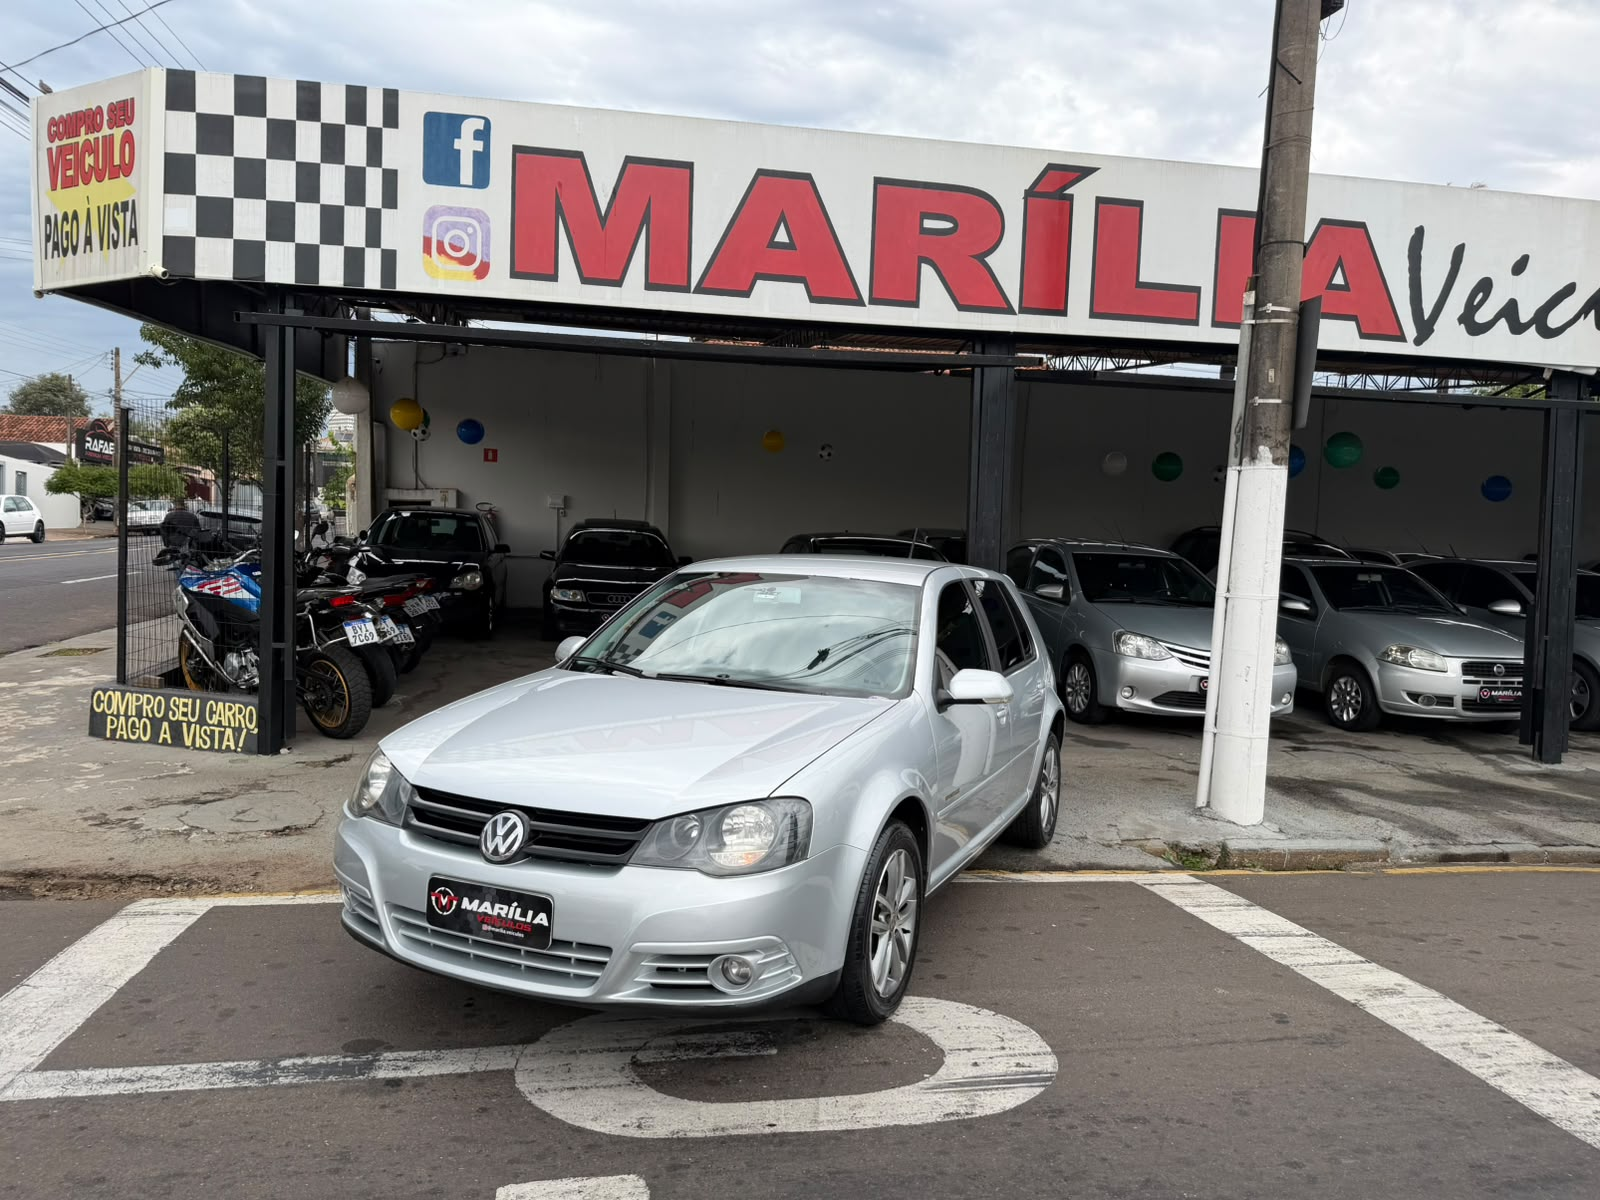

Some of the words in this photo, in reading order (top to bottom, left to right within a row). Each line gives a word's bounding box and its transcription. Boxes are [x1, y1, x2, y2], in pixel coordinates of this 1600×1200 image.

[47, 105, 104, 143] COMPRO
[107, 97, 135, 130] SEU
[46, 129, 135, 191] VEICULO
[44, 209, 80, 260] PAGO
[83, 195, 93, 254] À
[97, 199, 138, 251] VISTA
[509, 144, 1408, 343] MARÍLIA
[1407, 225, 1600, 347] Veic
[93, 690, 165, 718] COMPRO
[168, 696, 200, 723] SEU
[106, 715, 151, 742] PAGO
[158, 721, 172, 745] A
[182, 721, 247, 753] VISTA!
[460, 896, 549, 927] MARÍLIA
